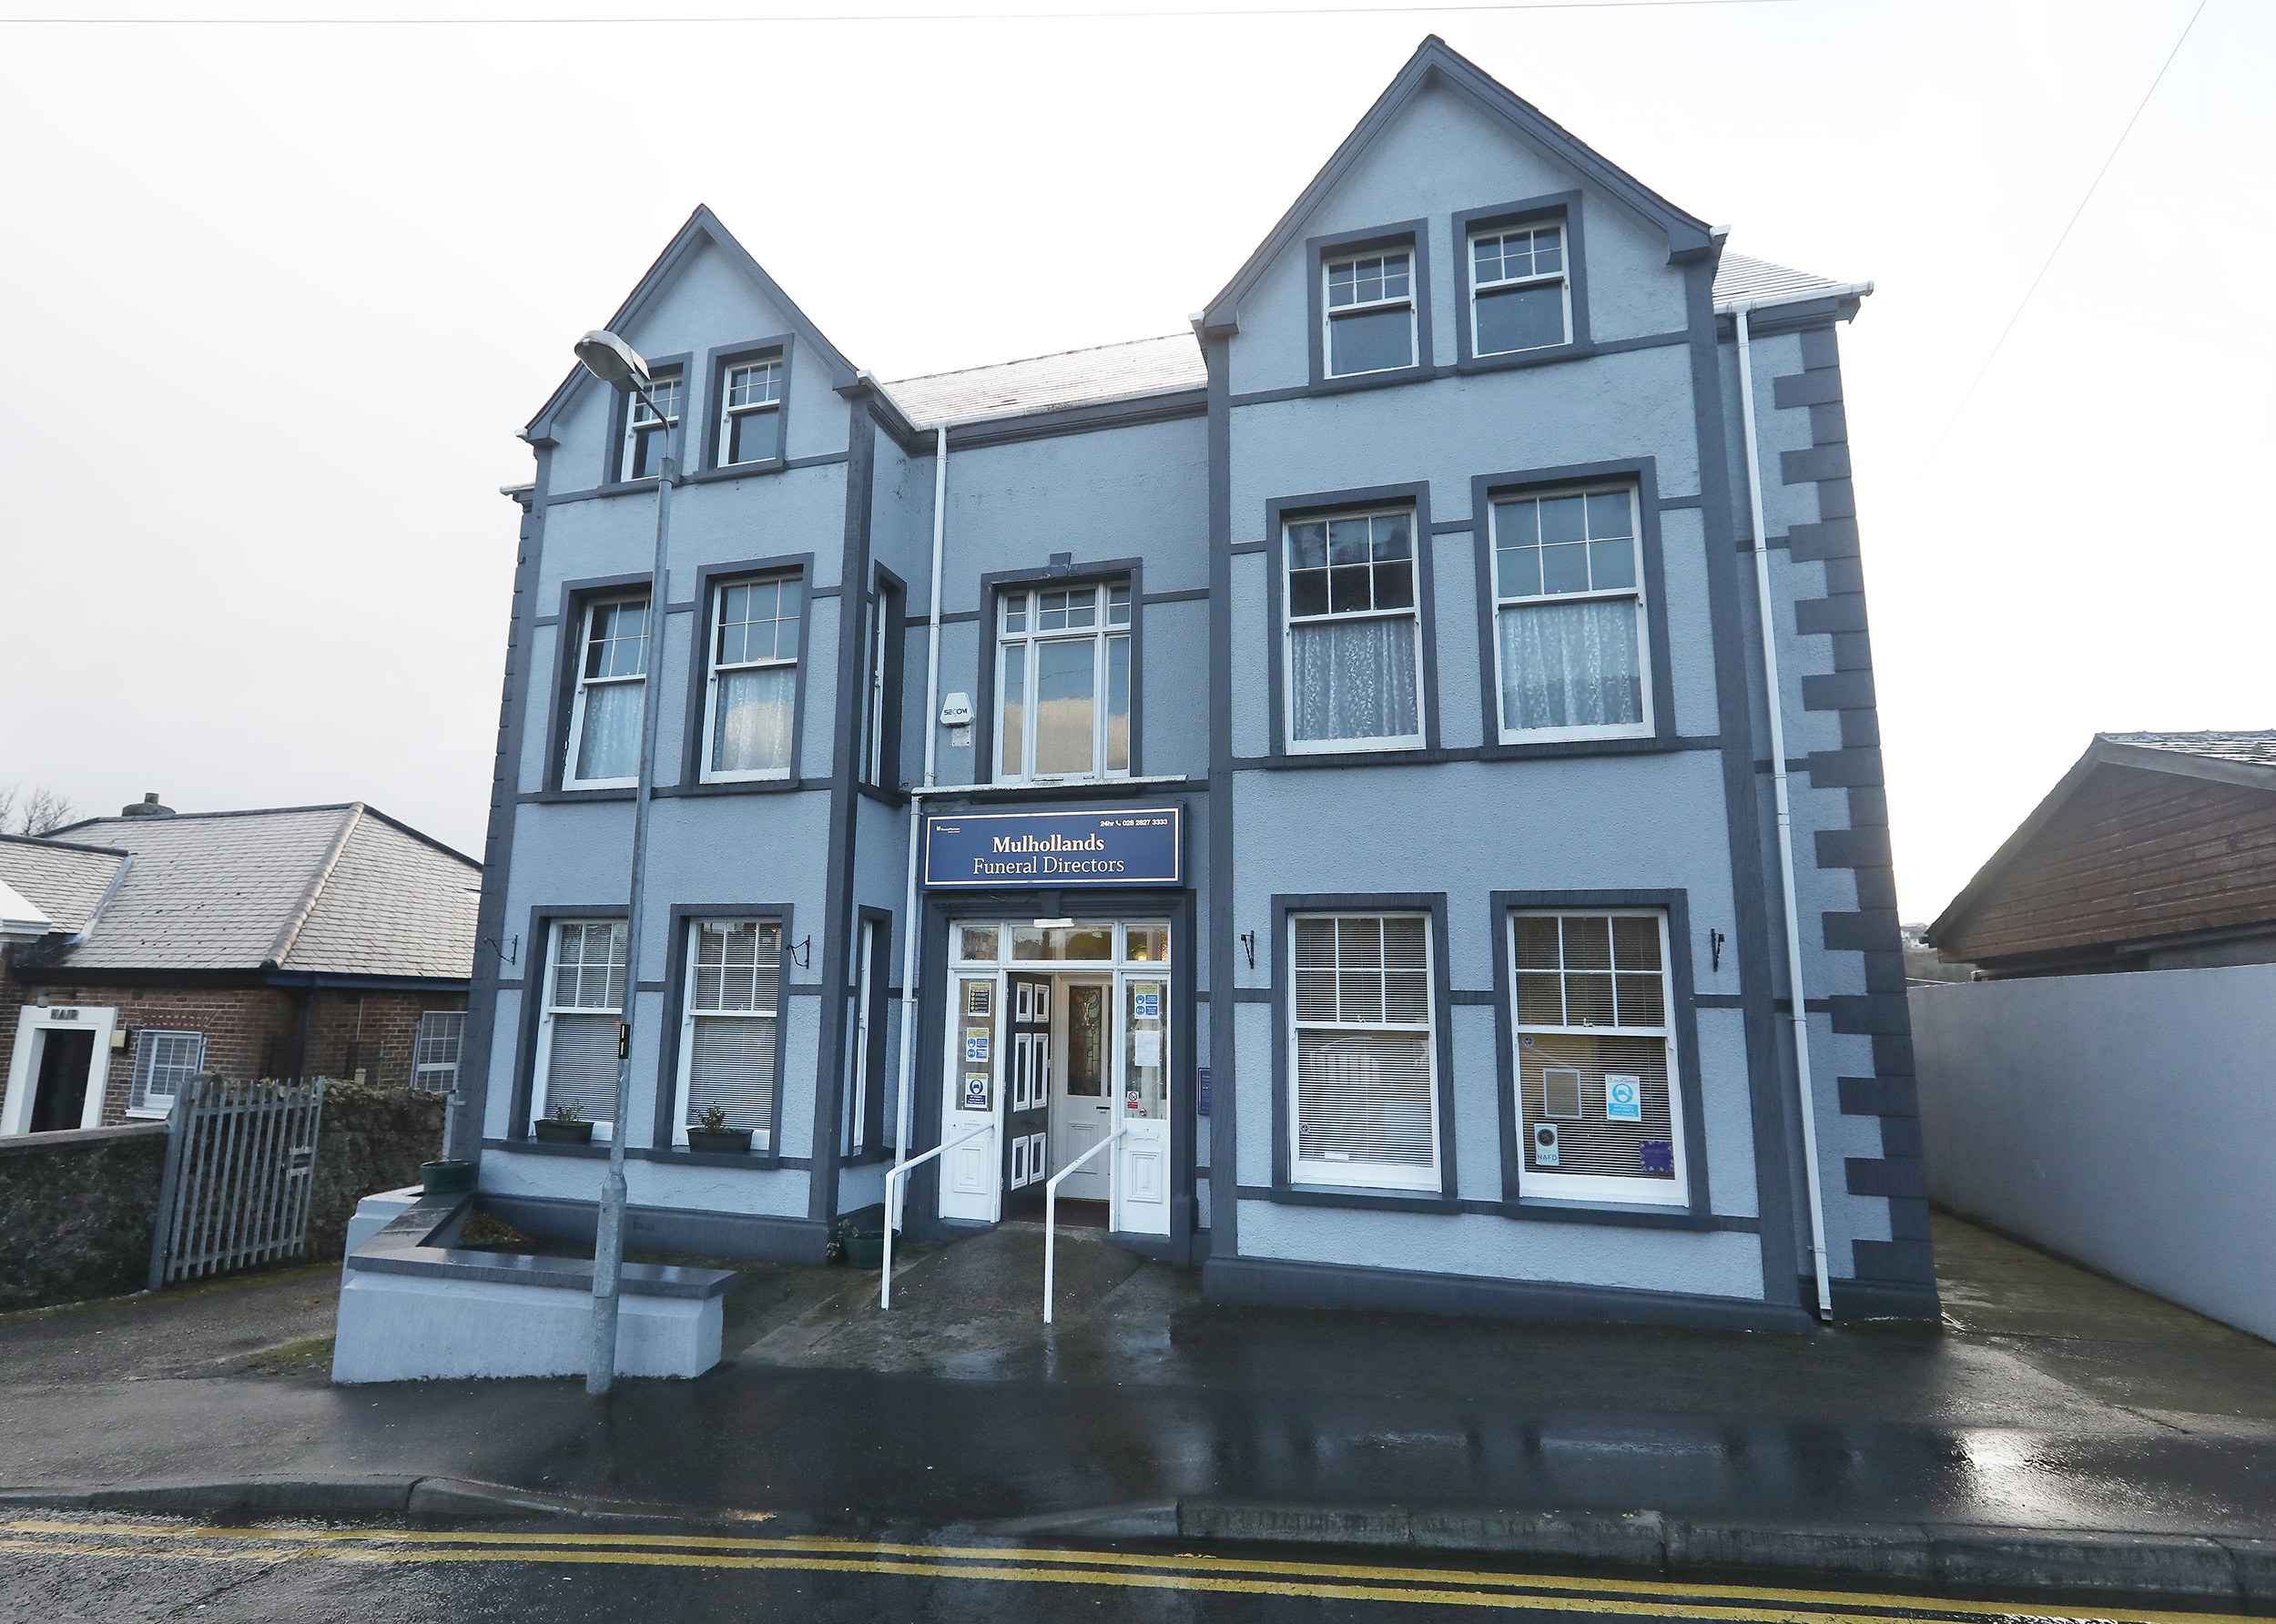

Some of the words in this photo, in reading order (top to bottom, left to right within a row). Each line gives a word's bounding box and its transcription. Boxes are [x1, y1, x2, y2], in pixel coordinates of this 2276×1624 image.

[943, 707, 968, 716] SECOM
[991, 833, 1105, 853] Mulhollands
[972, 856, 1038, 875] Funeral
[1042, 856, 1125, 874] Directors
[1537, 1153, 1558, 1162] NAFD
